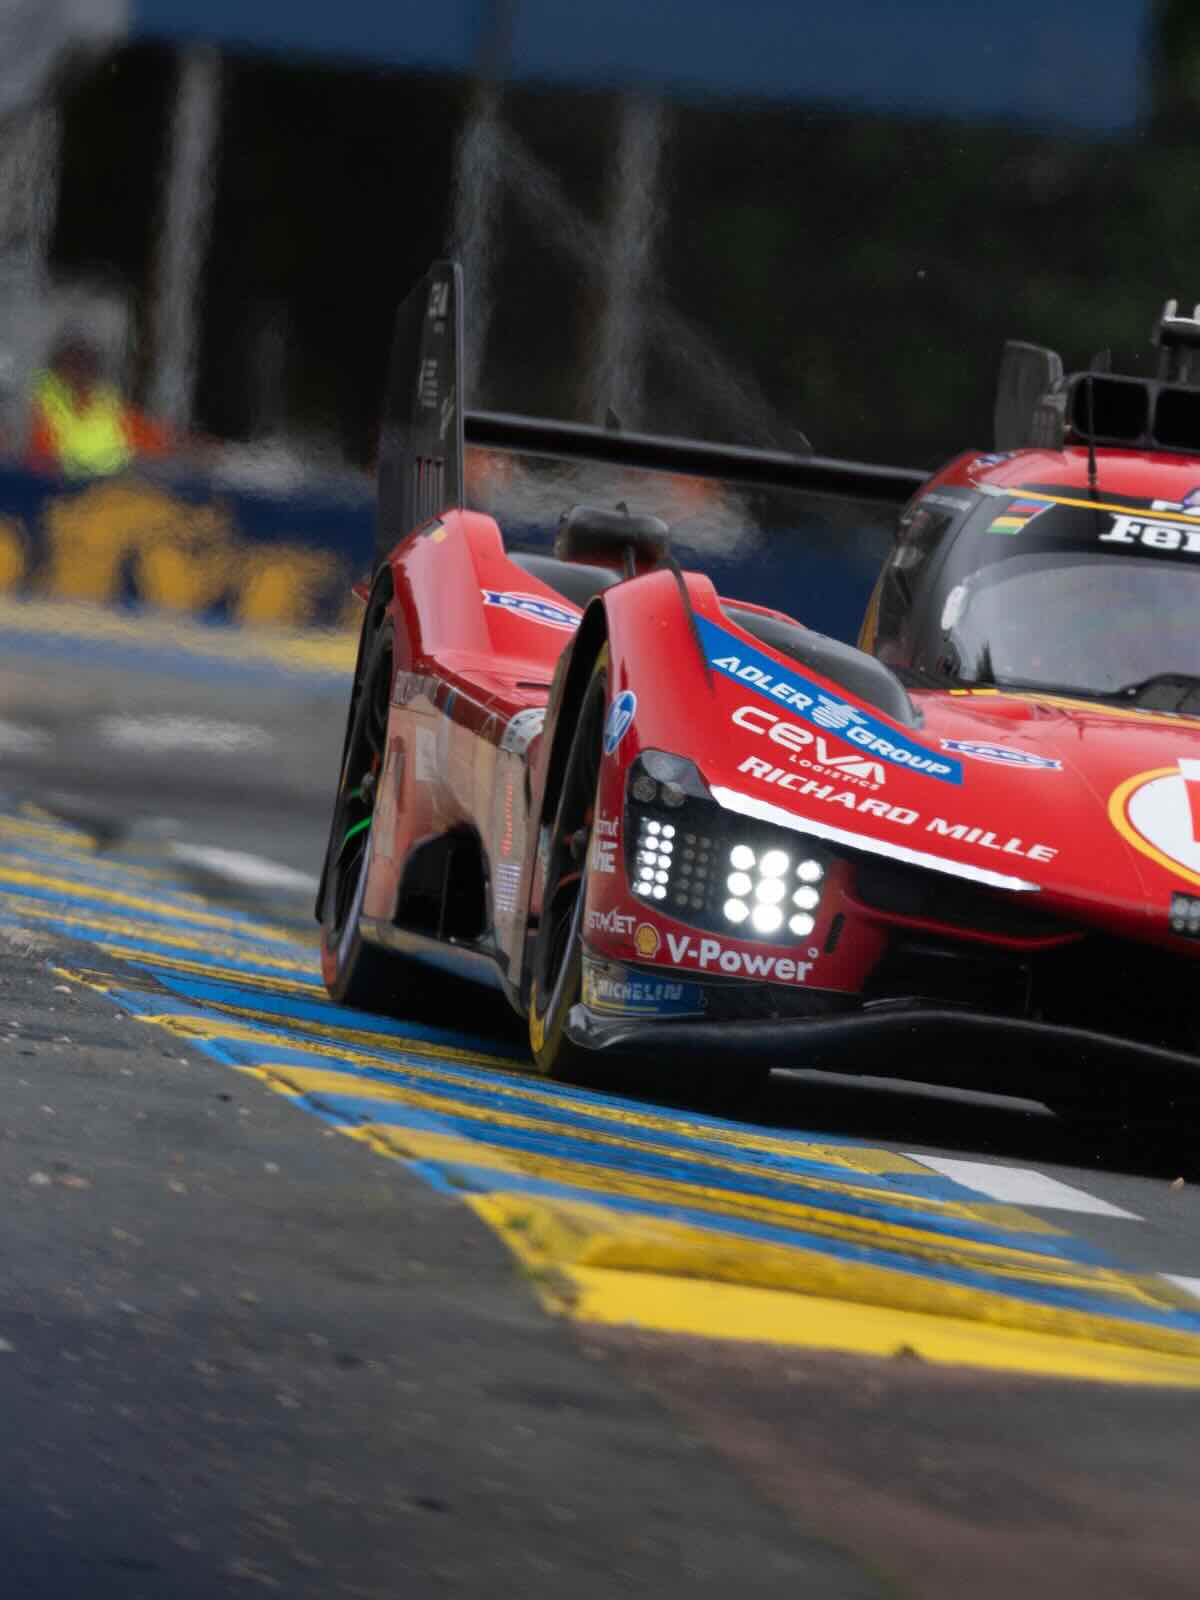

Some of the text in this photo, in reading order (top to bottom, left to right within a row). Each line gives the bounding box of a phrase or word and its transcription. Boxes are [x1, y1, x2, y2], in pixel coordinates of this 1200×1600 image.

[712, 656, 813, 710] ADLER
[846, 726, 952, 775] GROUP
[737, 756, 1059, 863] RICHARD MILLE
[789, 754, 881, 791] LOGISTICS
[666, 932, 814, 982] V-Power
